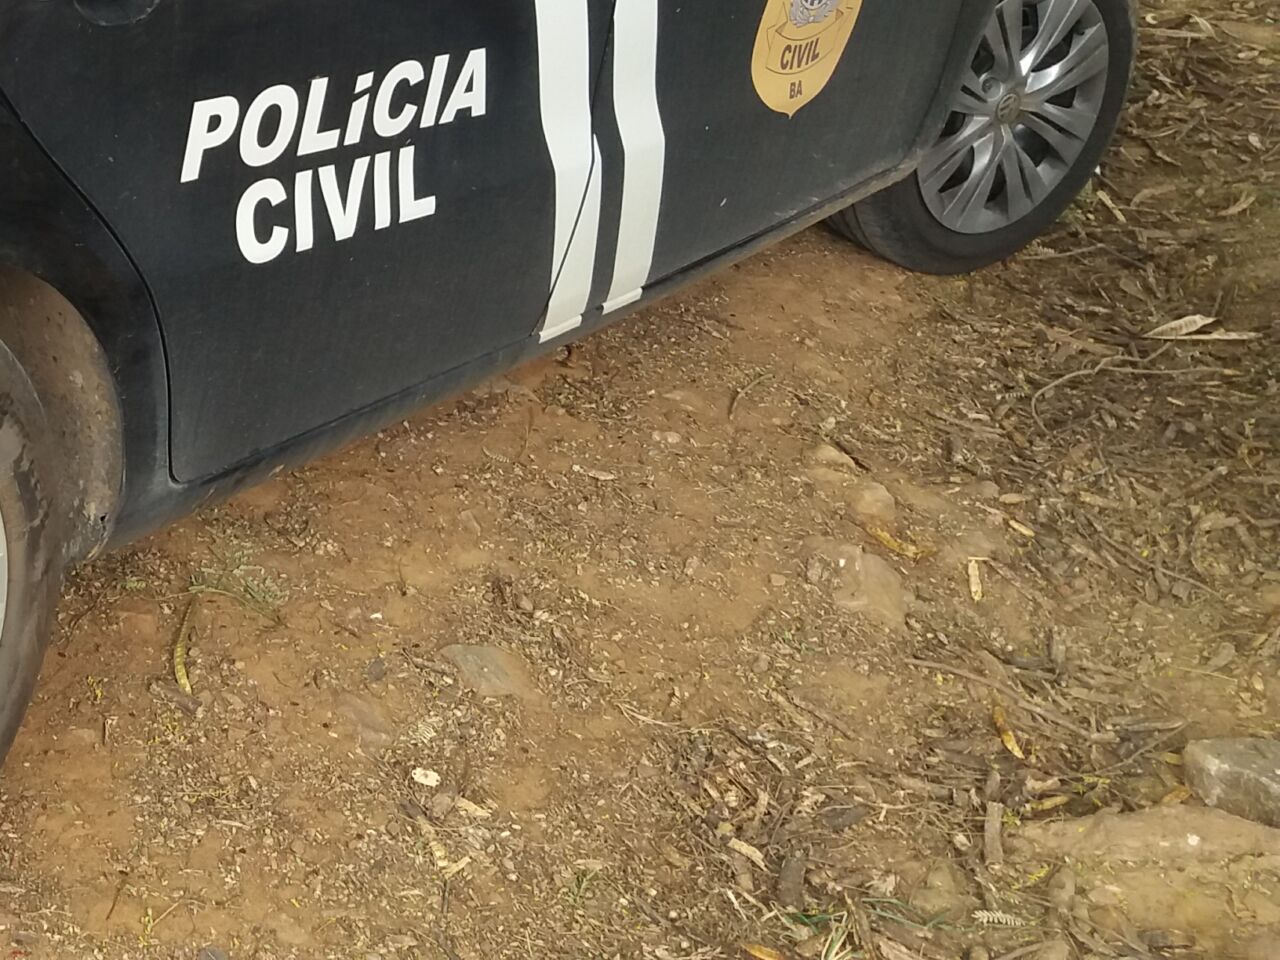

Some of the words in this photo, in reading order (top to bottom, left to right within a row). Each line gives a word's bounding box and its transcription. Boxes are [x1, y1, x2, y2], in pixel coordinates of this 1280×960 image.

[780, 38, 820, 71] CIVIL
[789, 79, 803, 100] BA
[235, 145, 436, 264] CIVIL
